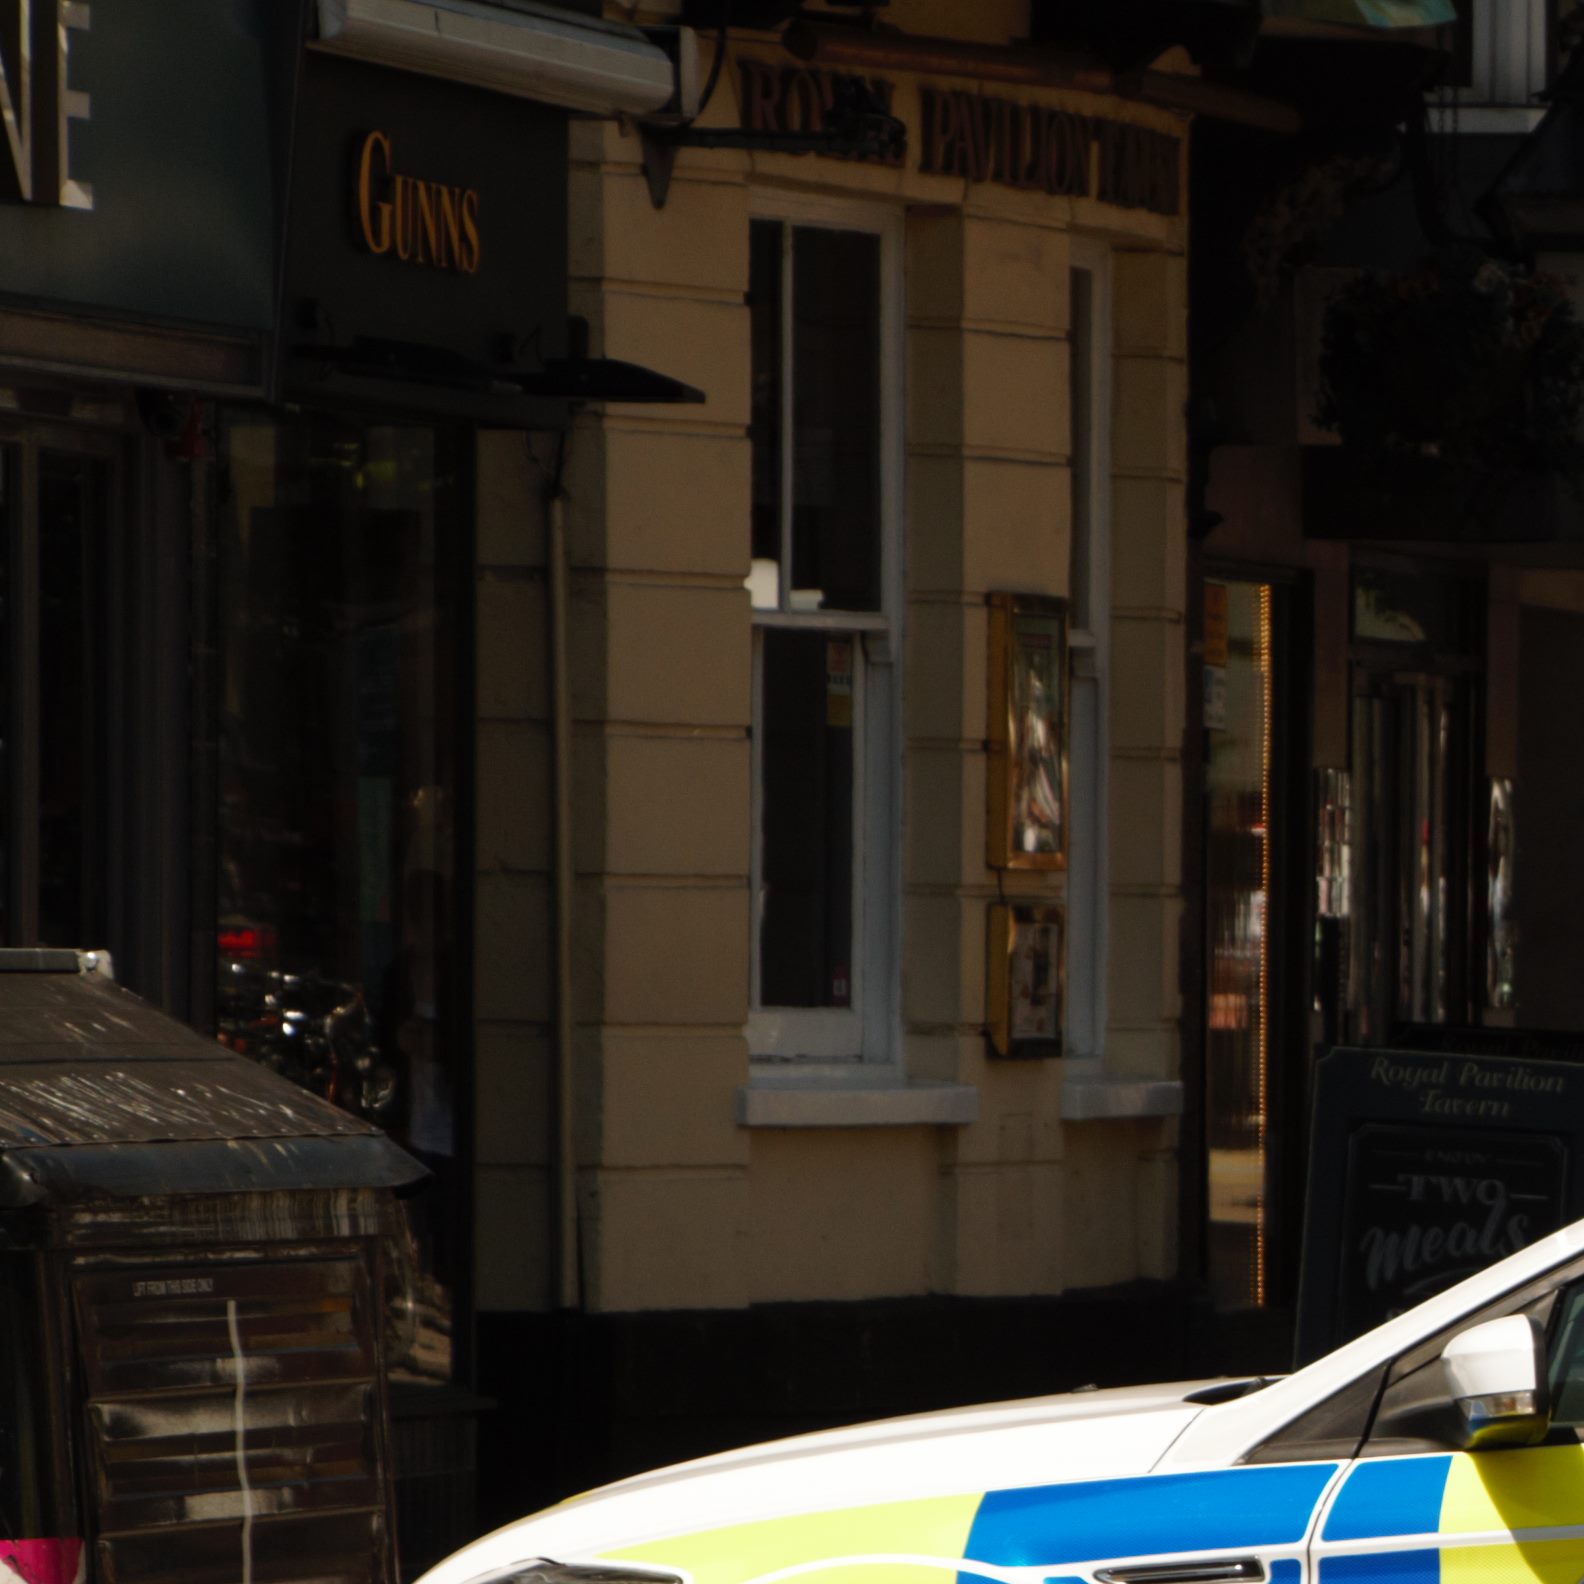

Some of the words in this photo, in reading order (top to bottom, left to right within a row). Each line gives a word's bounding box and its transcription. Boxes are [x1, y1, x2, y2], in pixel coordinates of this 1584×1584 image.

[918, 83, 1095, 198] PAVILION
[357, 129, 481, 274] GUNNS
[1368, 1056, 1450, 1090] Royal
[1458, 1064, 1566, 1095] Pavilion
[1420, 1088, 1513, 1118] Tavern
[1396, 1173, 1508, 1205] TWO
[1358, 1196, 1530, 1291] meals
